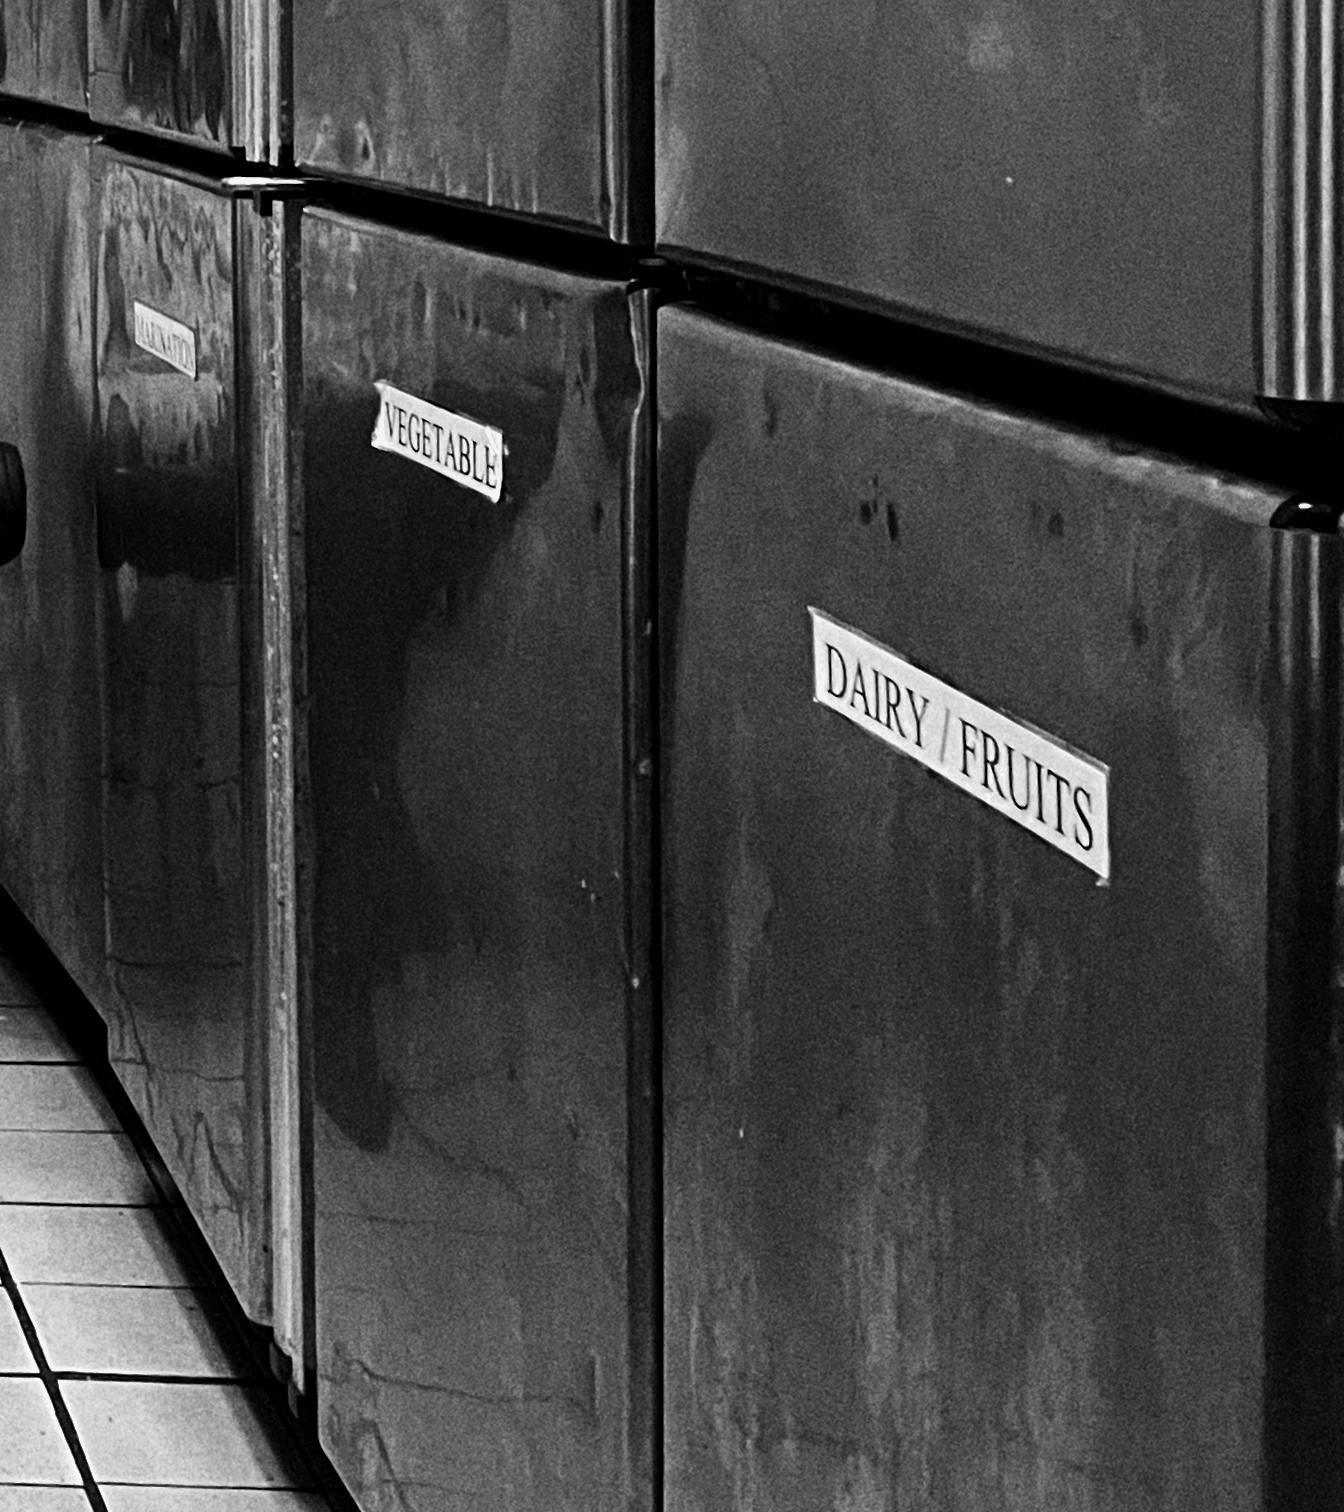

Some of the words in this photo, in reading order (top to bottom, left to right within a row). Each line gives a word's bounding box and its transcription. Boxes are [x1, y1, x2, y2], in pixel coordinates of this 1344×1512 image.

[385, 401, 498, 489] VEGETABLE
[825, 643, 930, 748] DAIRY
[959, 717, 1094, 852] FRUITS
